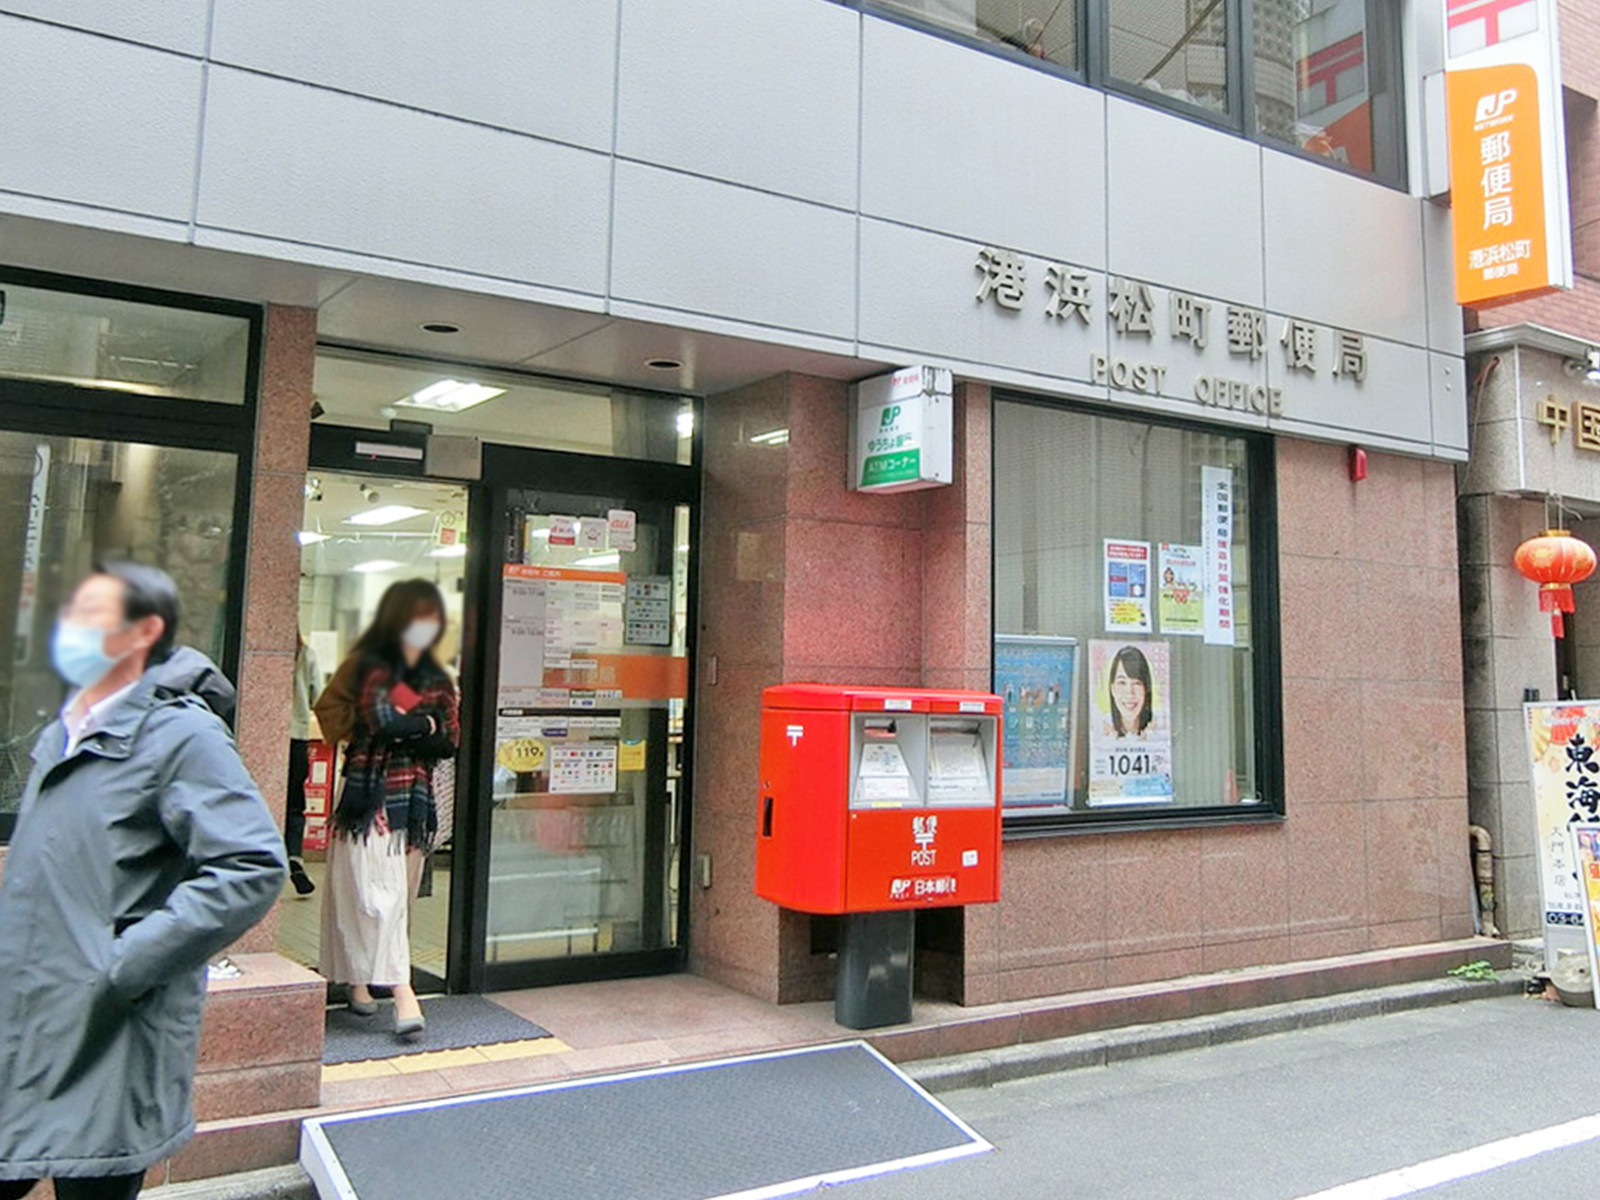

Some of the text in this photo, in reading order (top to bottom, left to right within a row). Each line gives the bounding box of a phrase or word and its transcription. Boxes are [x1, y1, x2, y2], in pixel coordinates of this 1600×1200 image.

[1475, 88, 1517, 122] JP
[1480, 130, 1514, 231] 郵便局
[1468, 239, 1531, 270] 港浜松町
[974, 246, 1368, 382] 港浜松町郵便局
[1090, 353, 1284, 417] POST OFFICE
[881, 405, 901, 426] JP
[911, 850, 937, 866] POST
